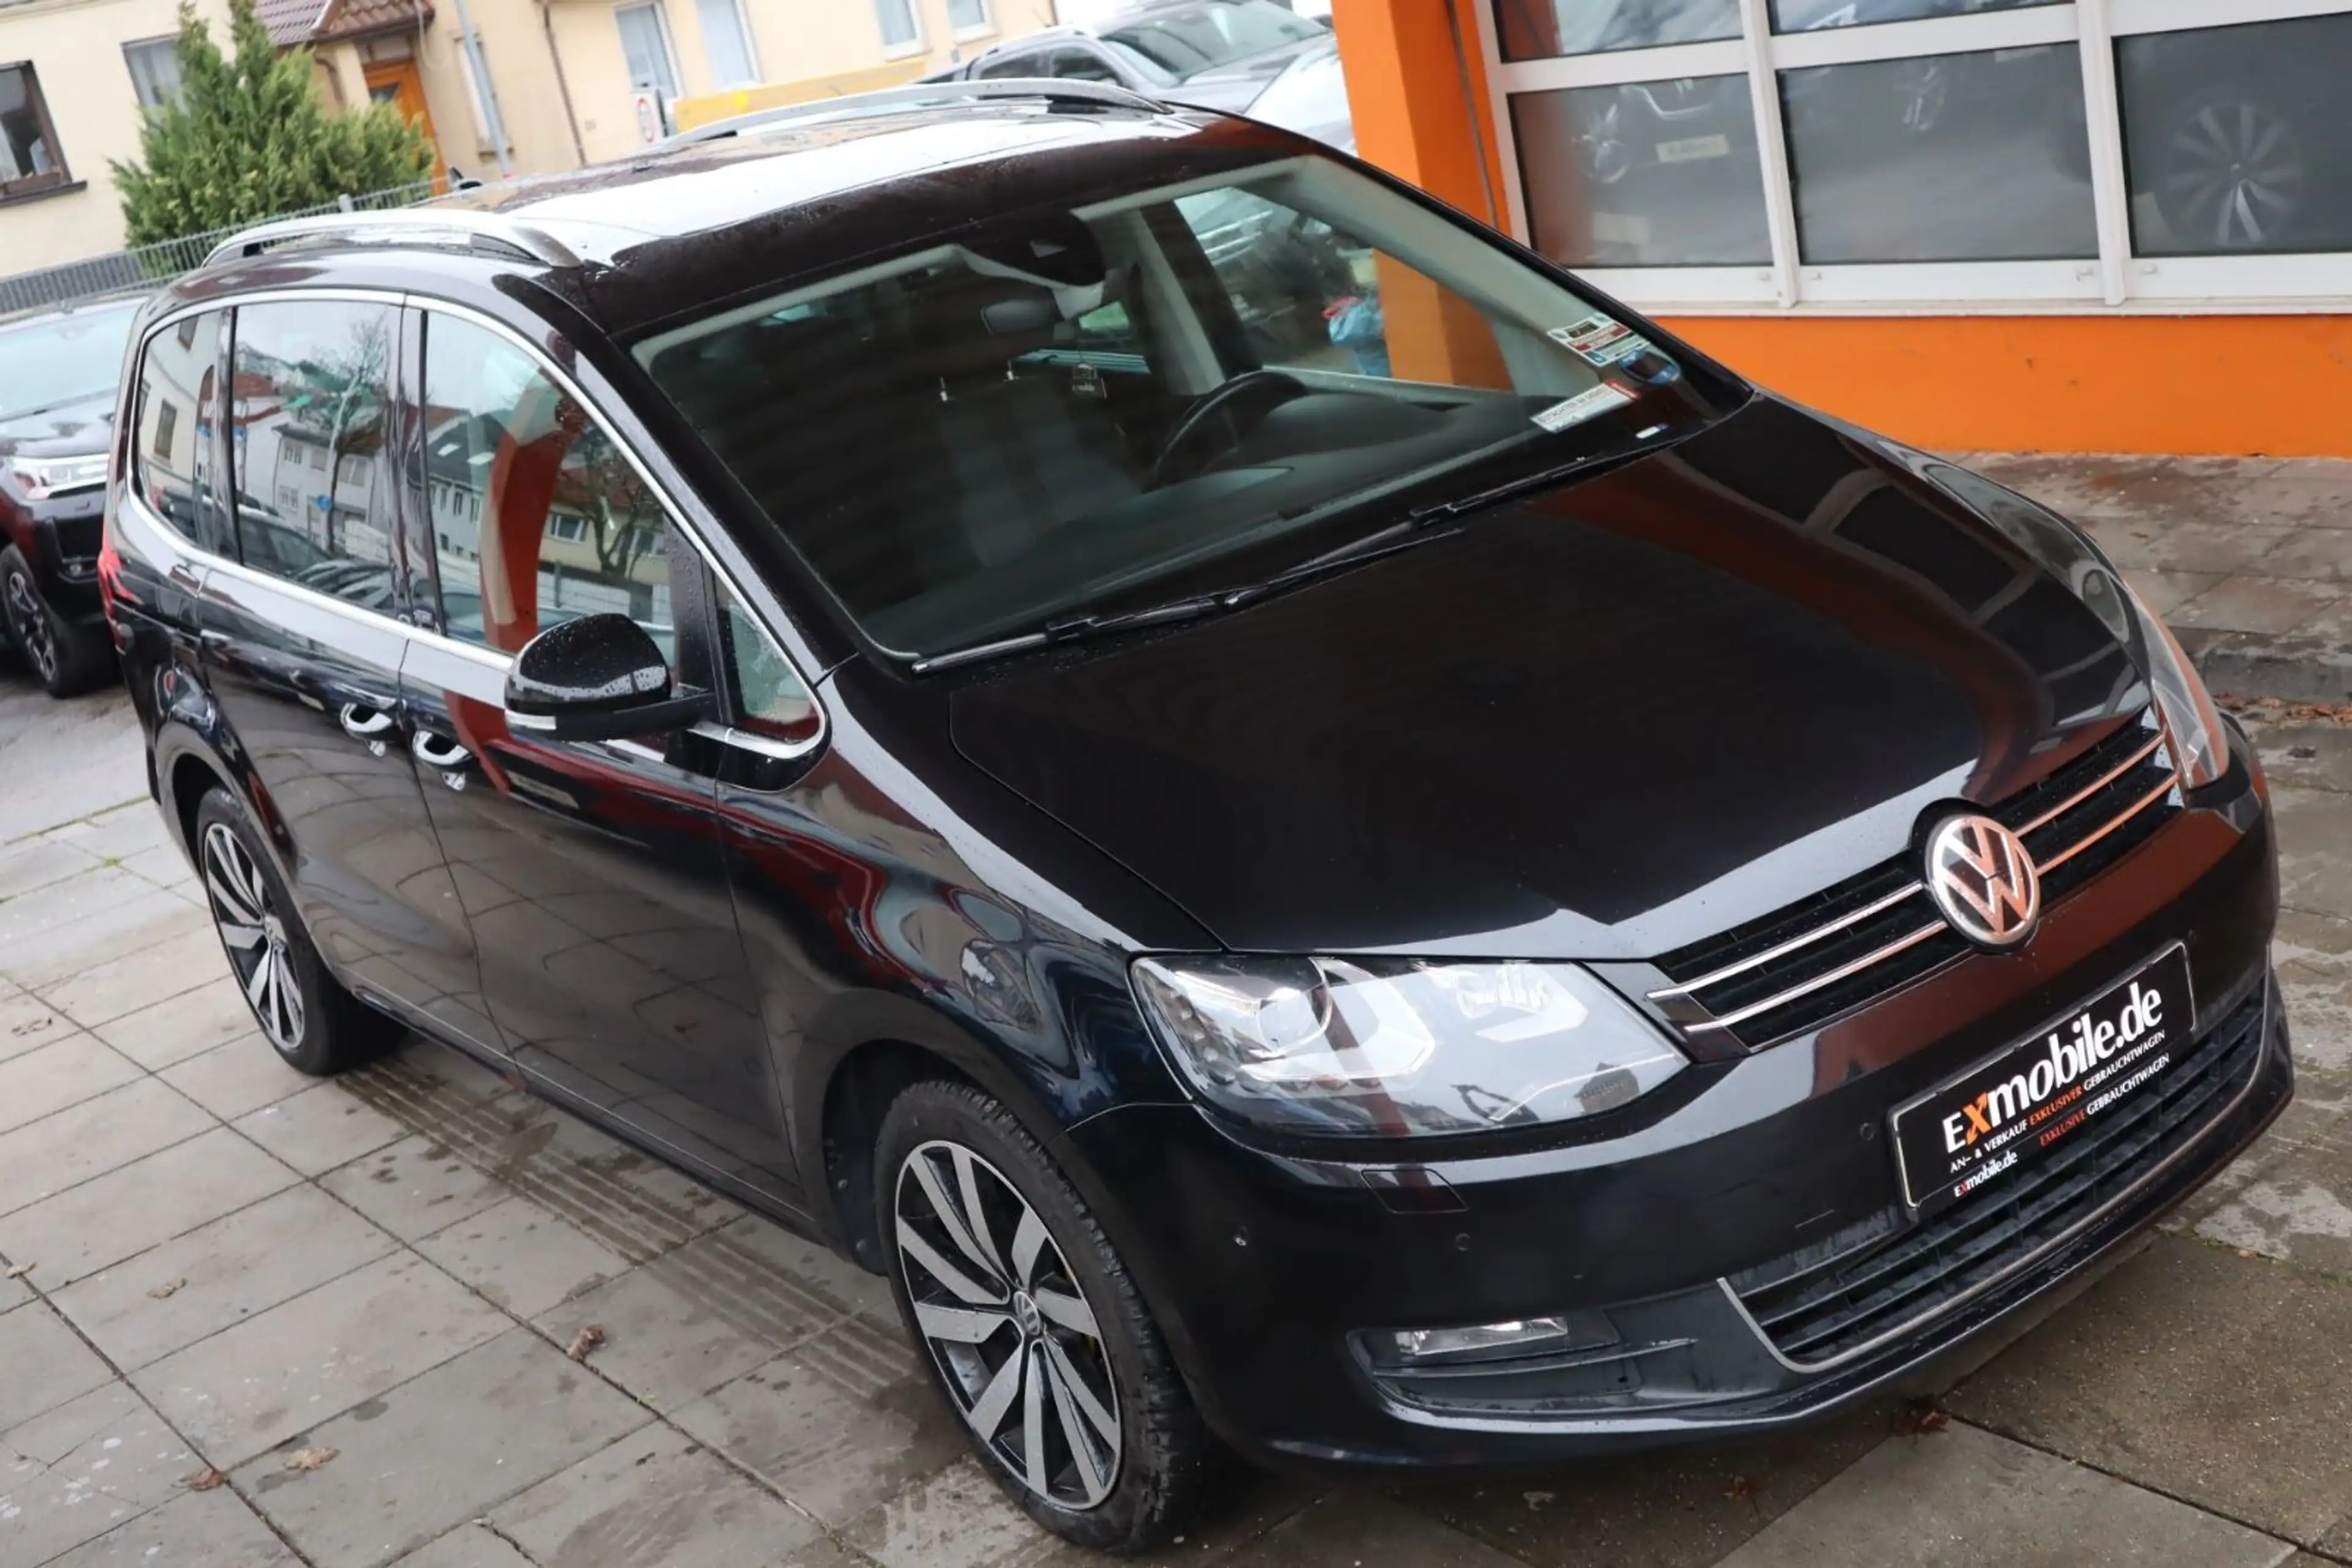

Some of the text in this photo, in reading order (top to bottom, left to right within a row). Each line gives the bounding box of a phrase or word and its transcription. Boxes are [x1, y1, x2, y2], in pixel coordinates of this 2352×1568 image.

[1932, 816, 2037, 939] VW
[1950, 1029, 2165, 1173] AN- & VERKAUF EXKLUSIVER GEBRAUCHTWAGEN
[2040, 1107, 2087, 1147] EXKLUSIVE
[2086, 1052, 2169, 1115] GEBRAUCHTWAGEN
